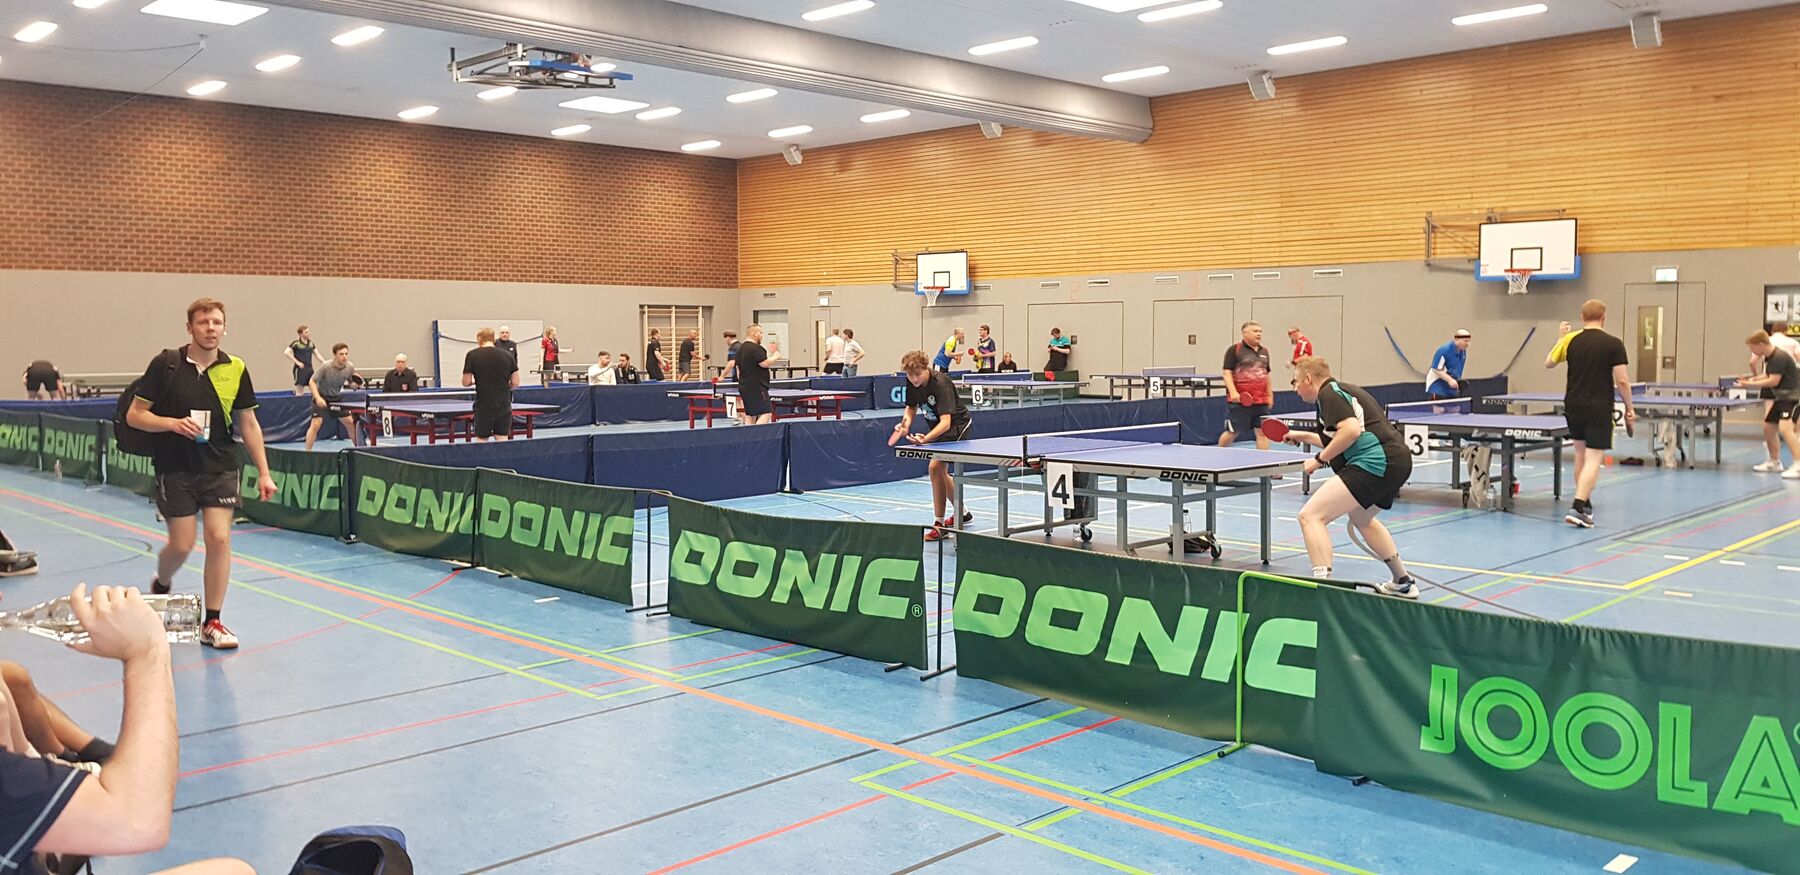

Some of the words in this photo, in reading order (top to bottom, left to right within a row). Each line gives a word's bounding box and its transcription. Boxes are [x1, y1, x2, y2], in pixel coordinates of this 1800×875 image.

[974, 389, 981, 402] 6
[1152, 381, 1159, 392] 5
[727, 402, 734, 417] 7
[1612, 410, 1624, 427] 2
[384, 417, 391, 436] 8
[1504, 428, 1543, 438] DONIC
[43, 427, 97, 462] DONIC
[1409, 433, 1424, 456] 3
[899, 450, 934, 460] DONIC
[1159, 470, 1209, 482] DONIC
[1051, 473, 1070, 505] 4
[479, 493, 634, 566] DONIC
[671, 529, 919, 620] DONIC
[953, 569, 1318, 698] DONIC
[1419, 663, 1800, 827] JOOLA
